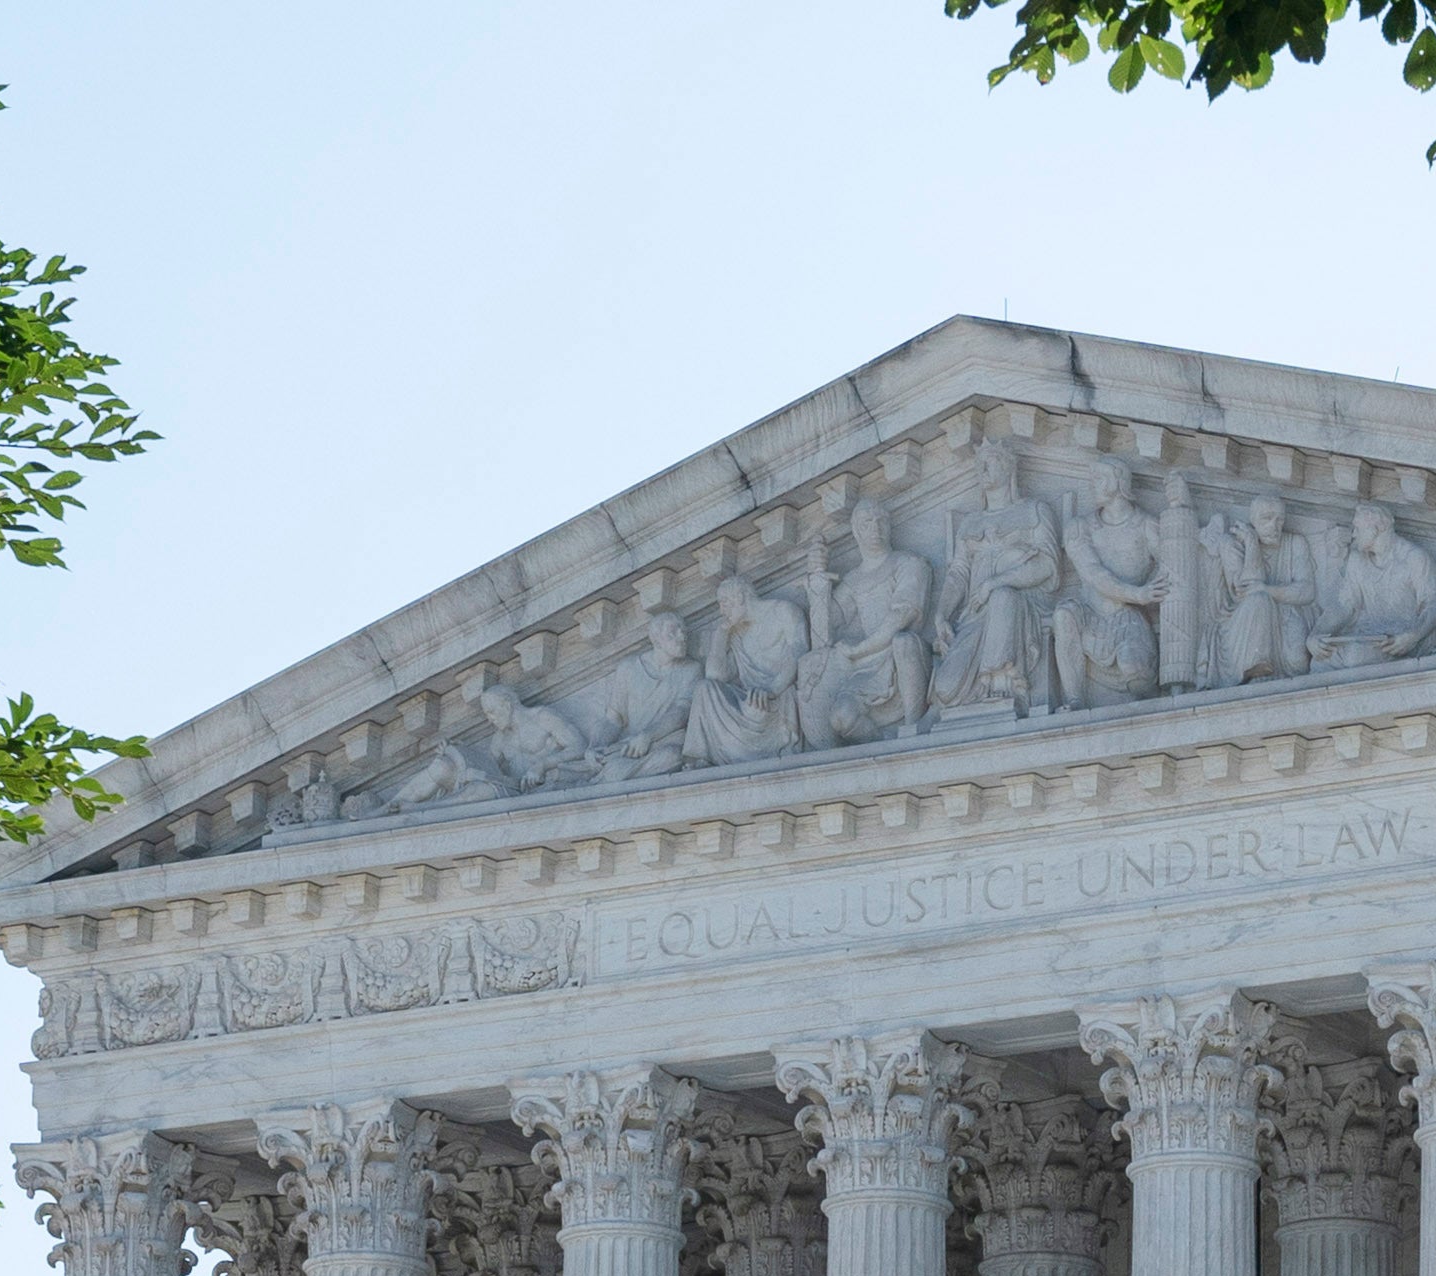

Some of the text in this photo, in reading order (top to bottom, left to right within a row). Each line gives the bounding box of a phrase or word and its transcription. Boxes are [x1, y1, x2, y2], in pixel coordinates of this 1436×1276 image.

[626, 807, 1412, 962] EQUAL JUSTICE UNDER LAW
